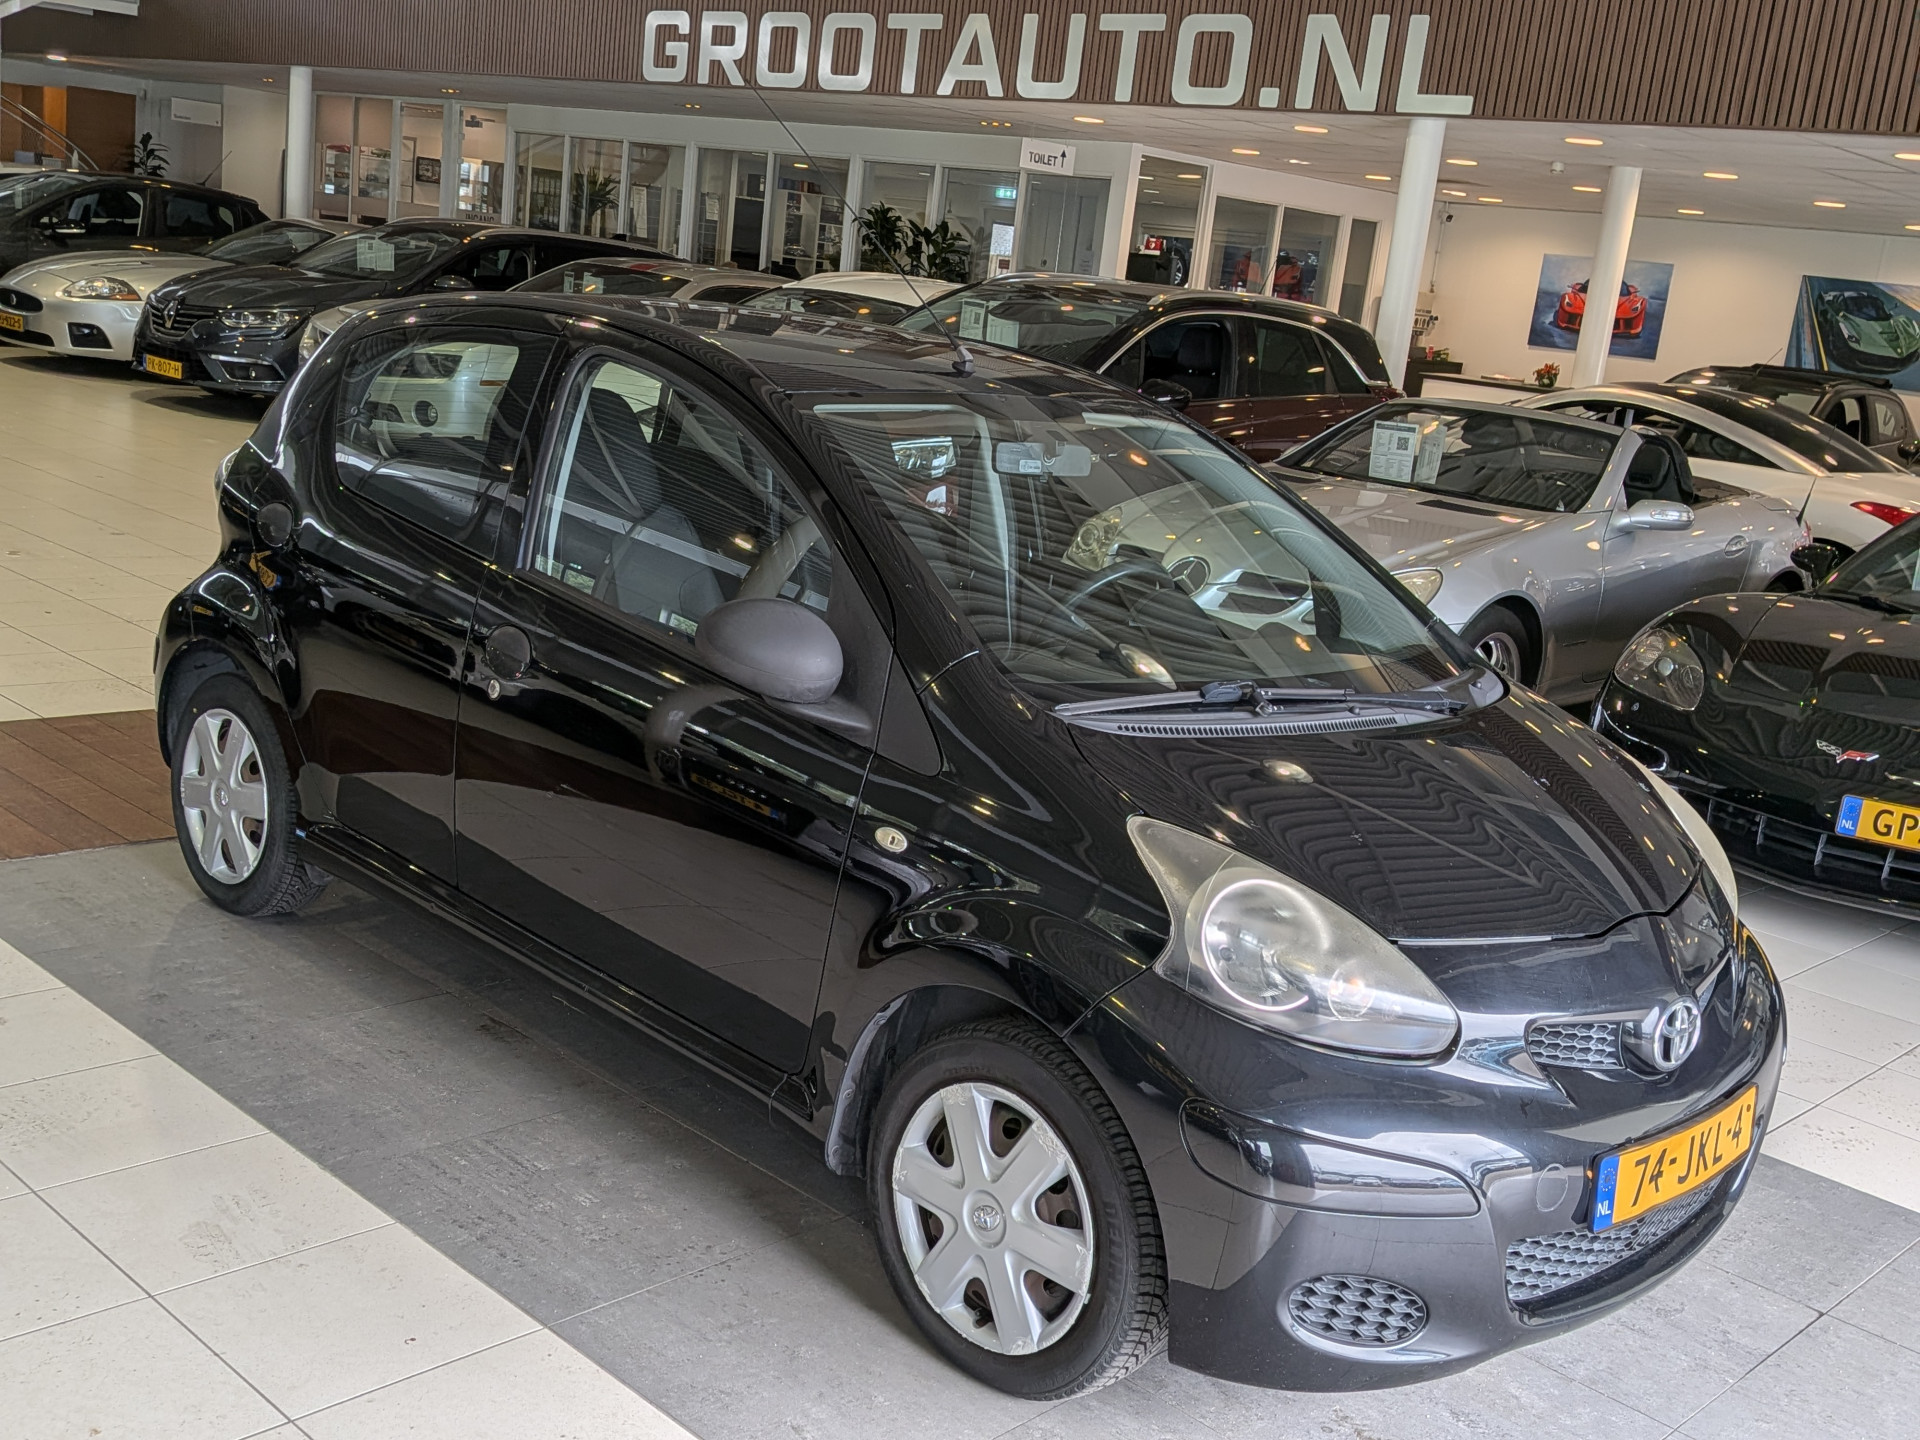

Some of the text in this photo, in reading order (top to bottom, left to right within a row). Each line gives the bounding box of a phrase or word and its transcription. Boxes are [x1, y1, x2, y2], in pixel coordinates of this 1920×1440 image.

[643, 10, 1474, 115] GROOTAUTO.NL
[1029, 151, 1059, 167] TOILET
[147, 356, 180, 377] PK-807-H
[1841, 819, 1855, 830] NL
[1872, 808, 1920, 844] GP
[1631, 1104, 1744, 1208] 74-JKL-4
[1596, 1200, 1612, 1218] NL
